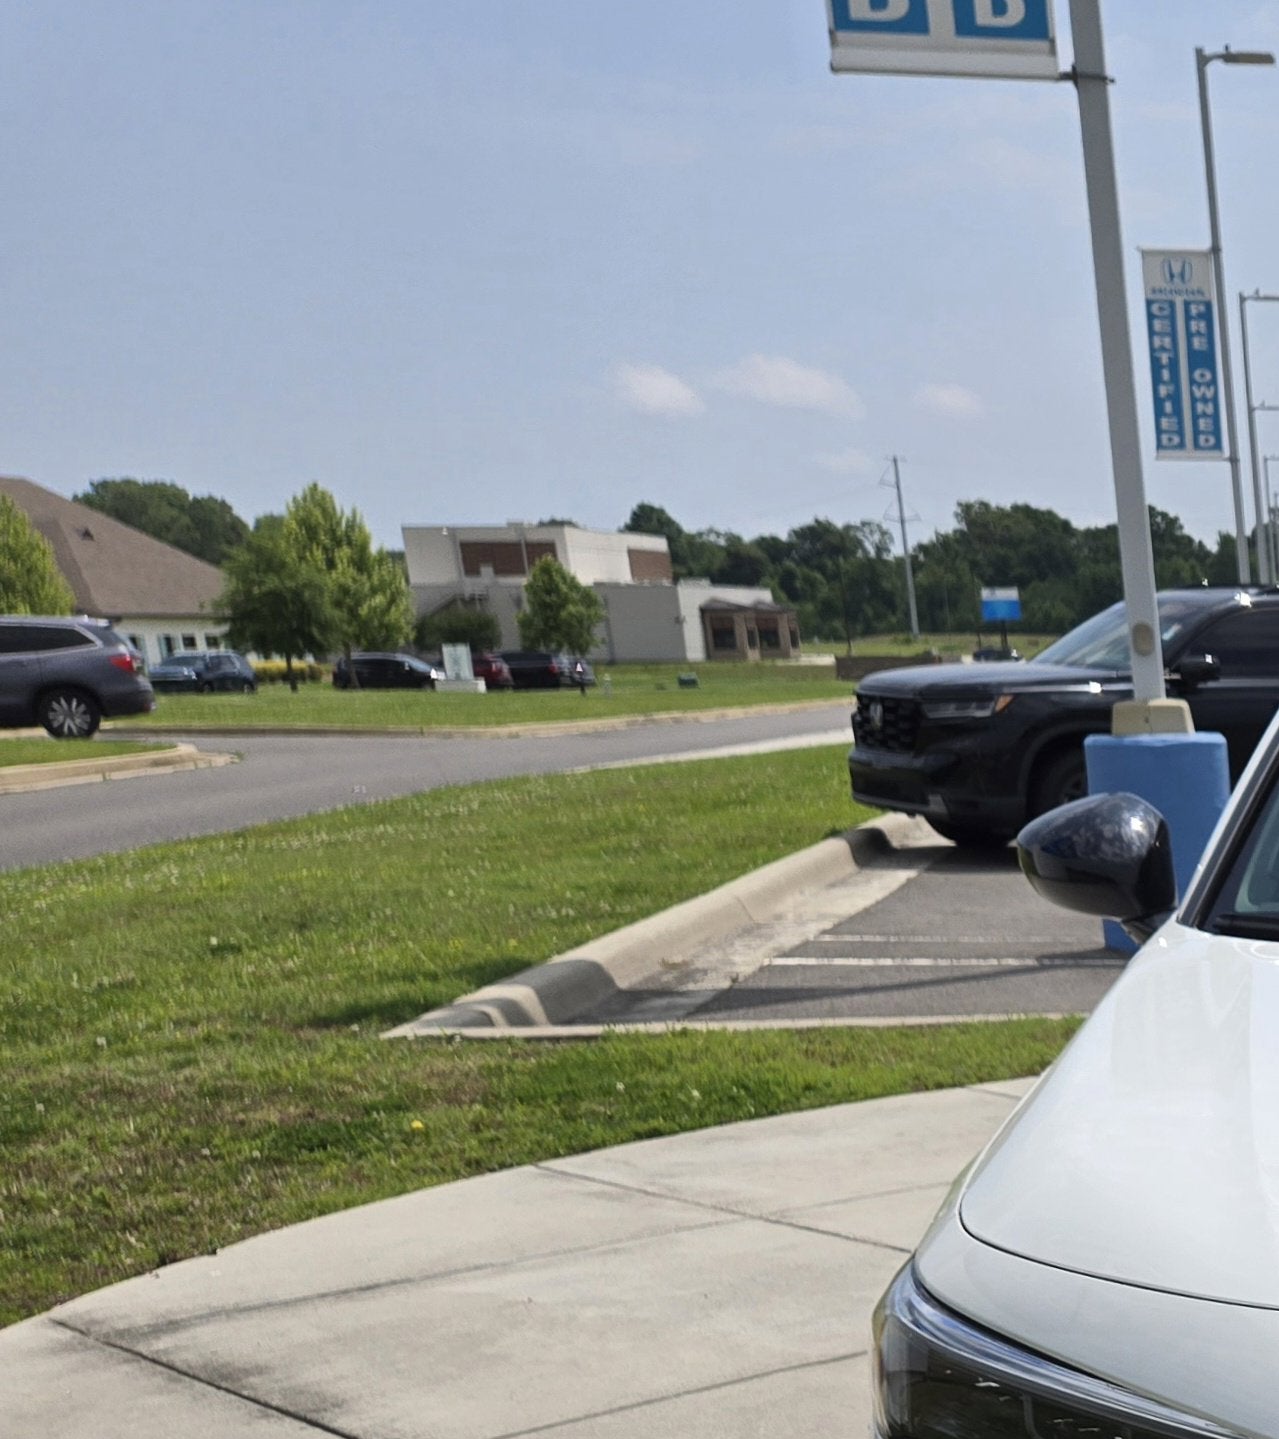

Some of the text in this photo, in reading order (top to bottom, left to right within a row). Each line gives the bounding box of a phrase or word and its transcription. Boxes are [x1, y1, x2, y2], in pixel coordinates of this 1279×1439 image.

[1151, 302, 1181, 447] CERTIFIED
[1189, 303, 1216, 447] PRE OWNED
